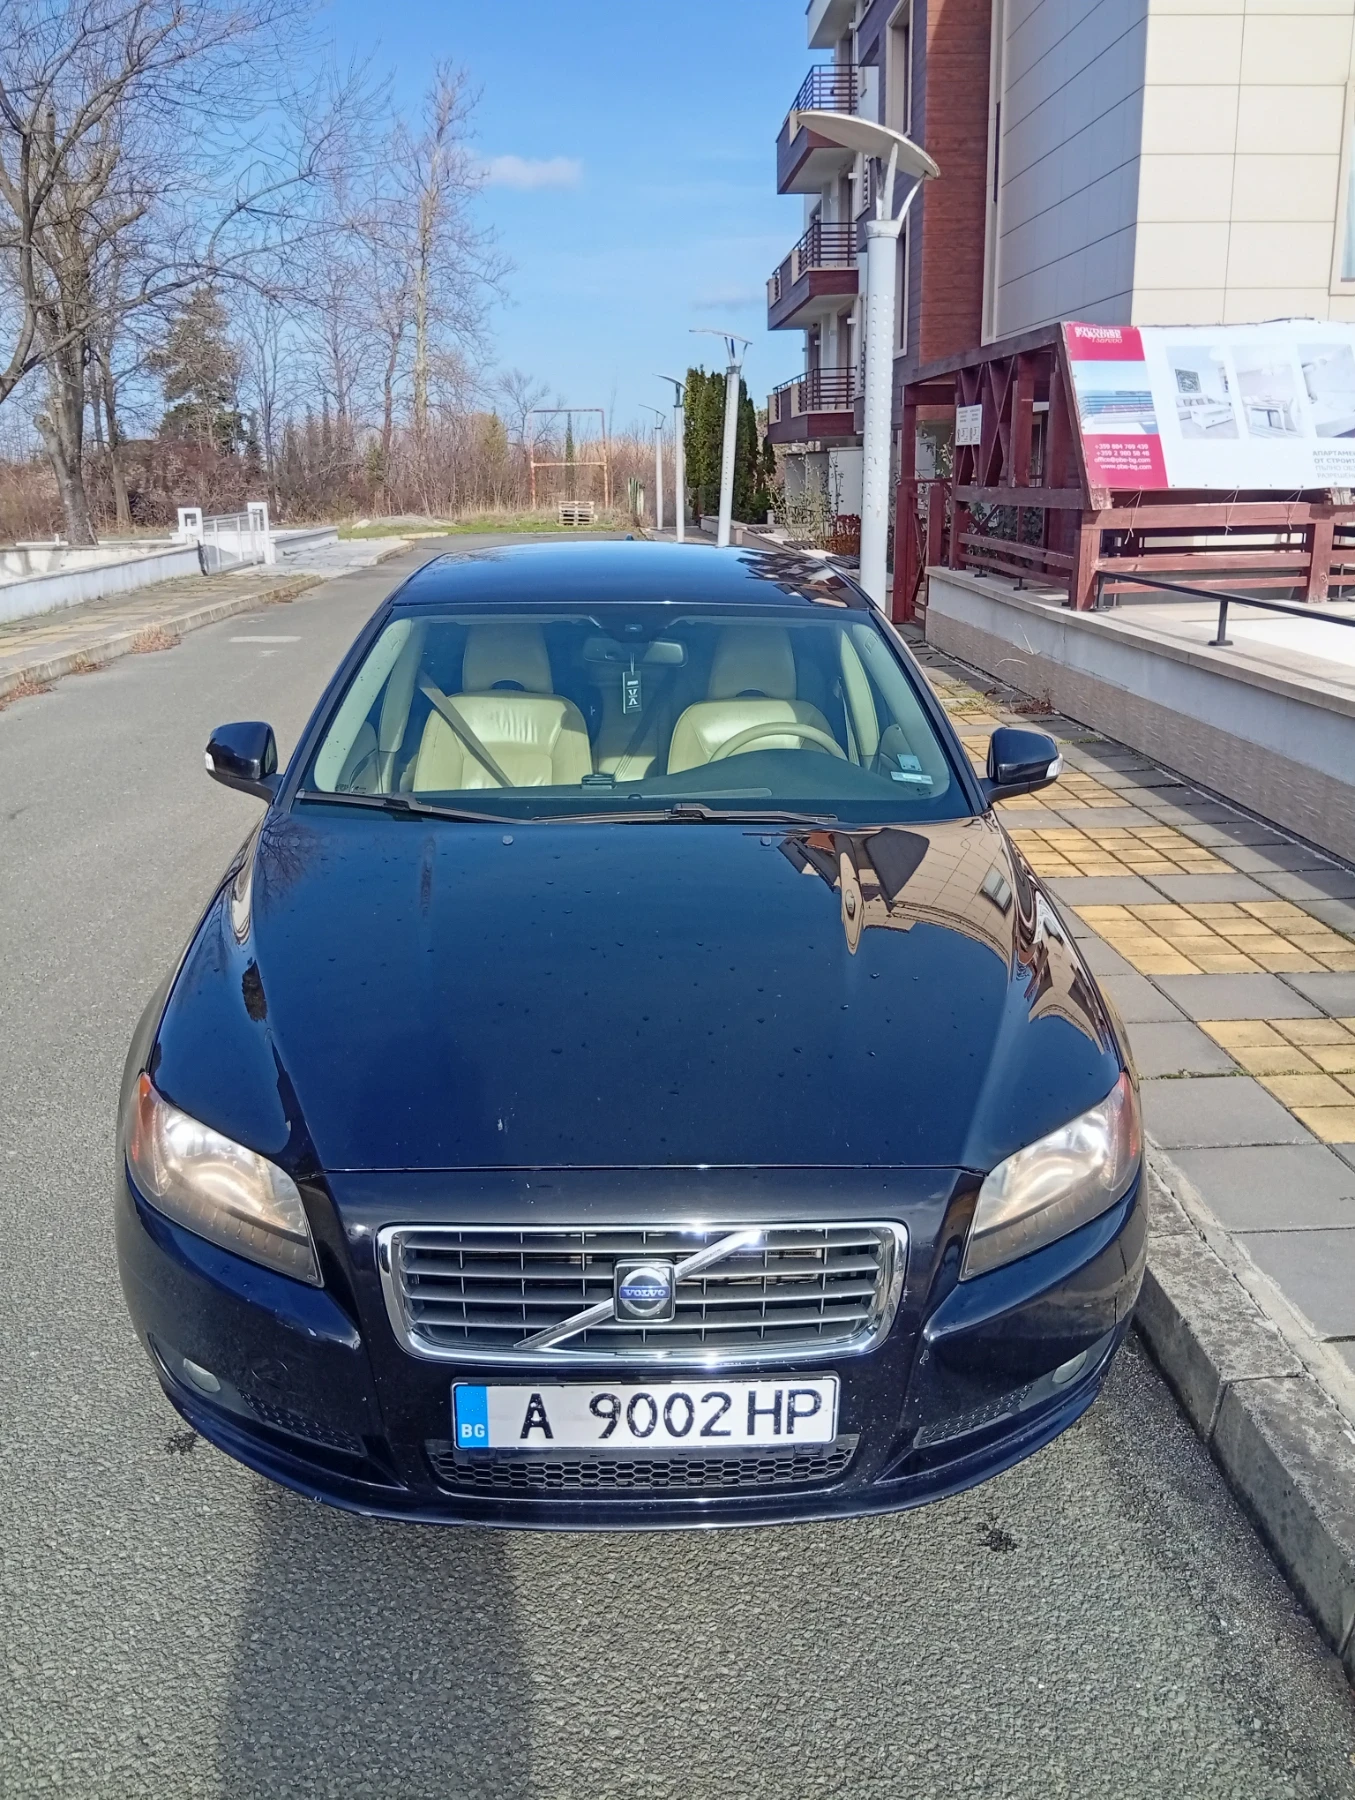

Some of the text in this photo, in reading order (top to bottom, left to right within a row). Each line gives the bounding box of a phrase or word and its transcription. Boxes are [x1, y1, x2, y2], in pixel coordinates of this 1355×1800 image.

[623, 1289, 666, 1297] VOLVO
[519, 1392, 555, 1440] A
[588, 1389, 732, 1440] 9002
[460, 1423, 486, 1439] BG
